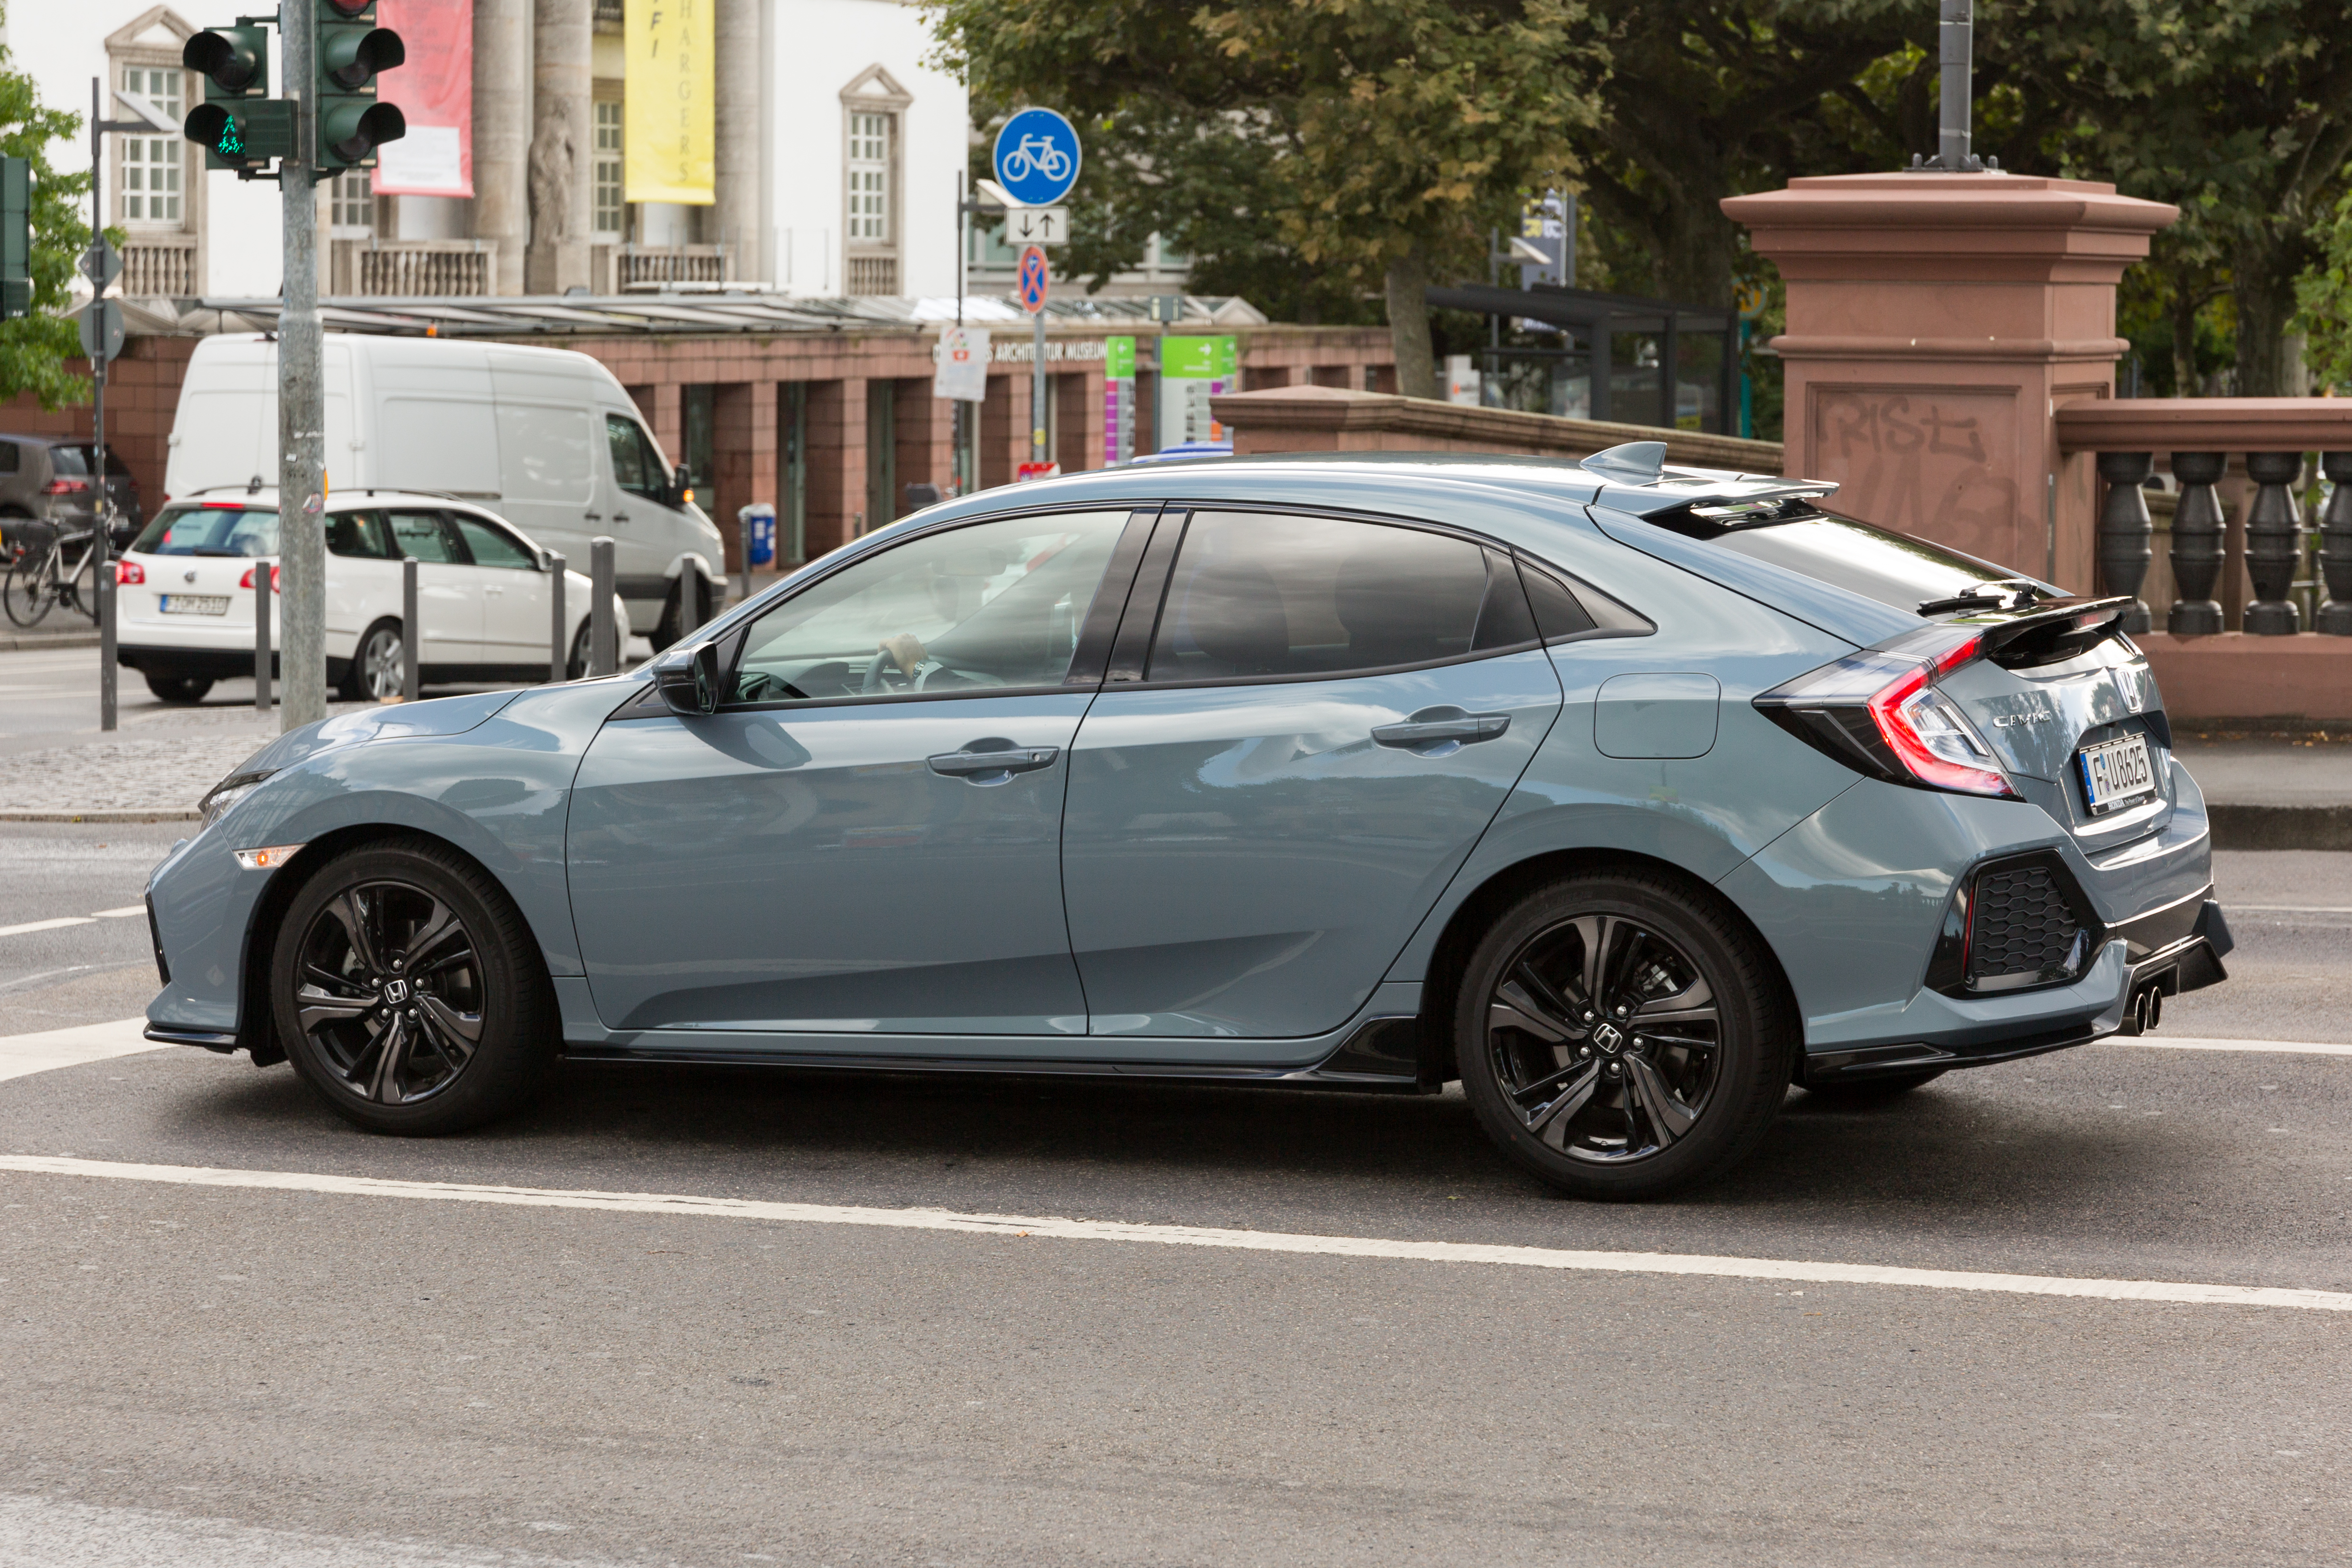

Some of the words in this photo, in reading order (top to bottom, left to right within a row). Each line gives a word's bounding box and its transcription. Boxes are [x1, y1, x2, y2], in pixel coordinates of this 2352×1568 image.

[650, 0, 663, 58] FI
[995, 342, 1063, 362] ARCHITTUR
[1993, 711, 2052, 727] CIVIC
[2108, 798, 2125, 810] HONDA
